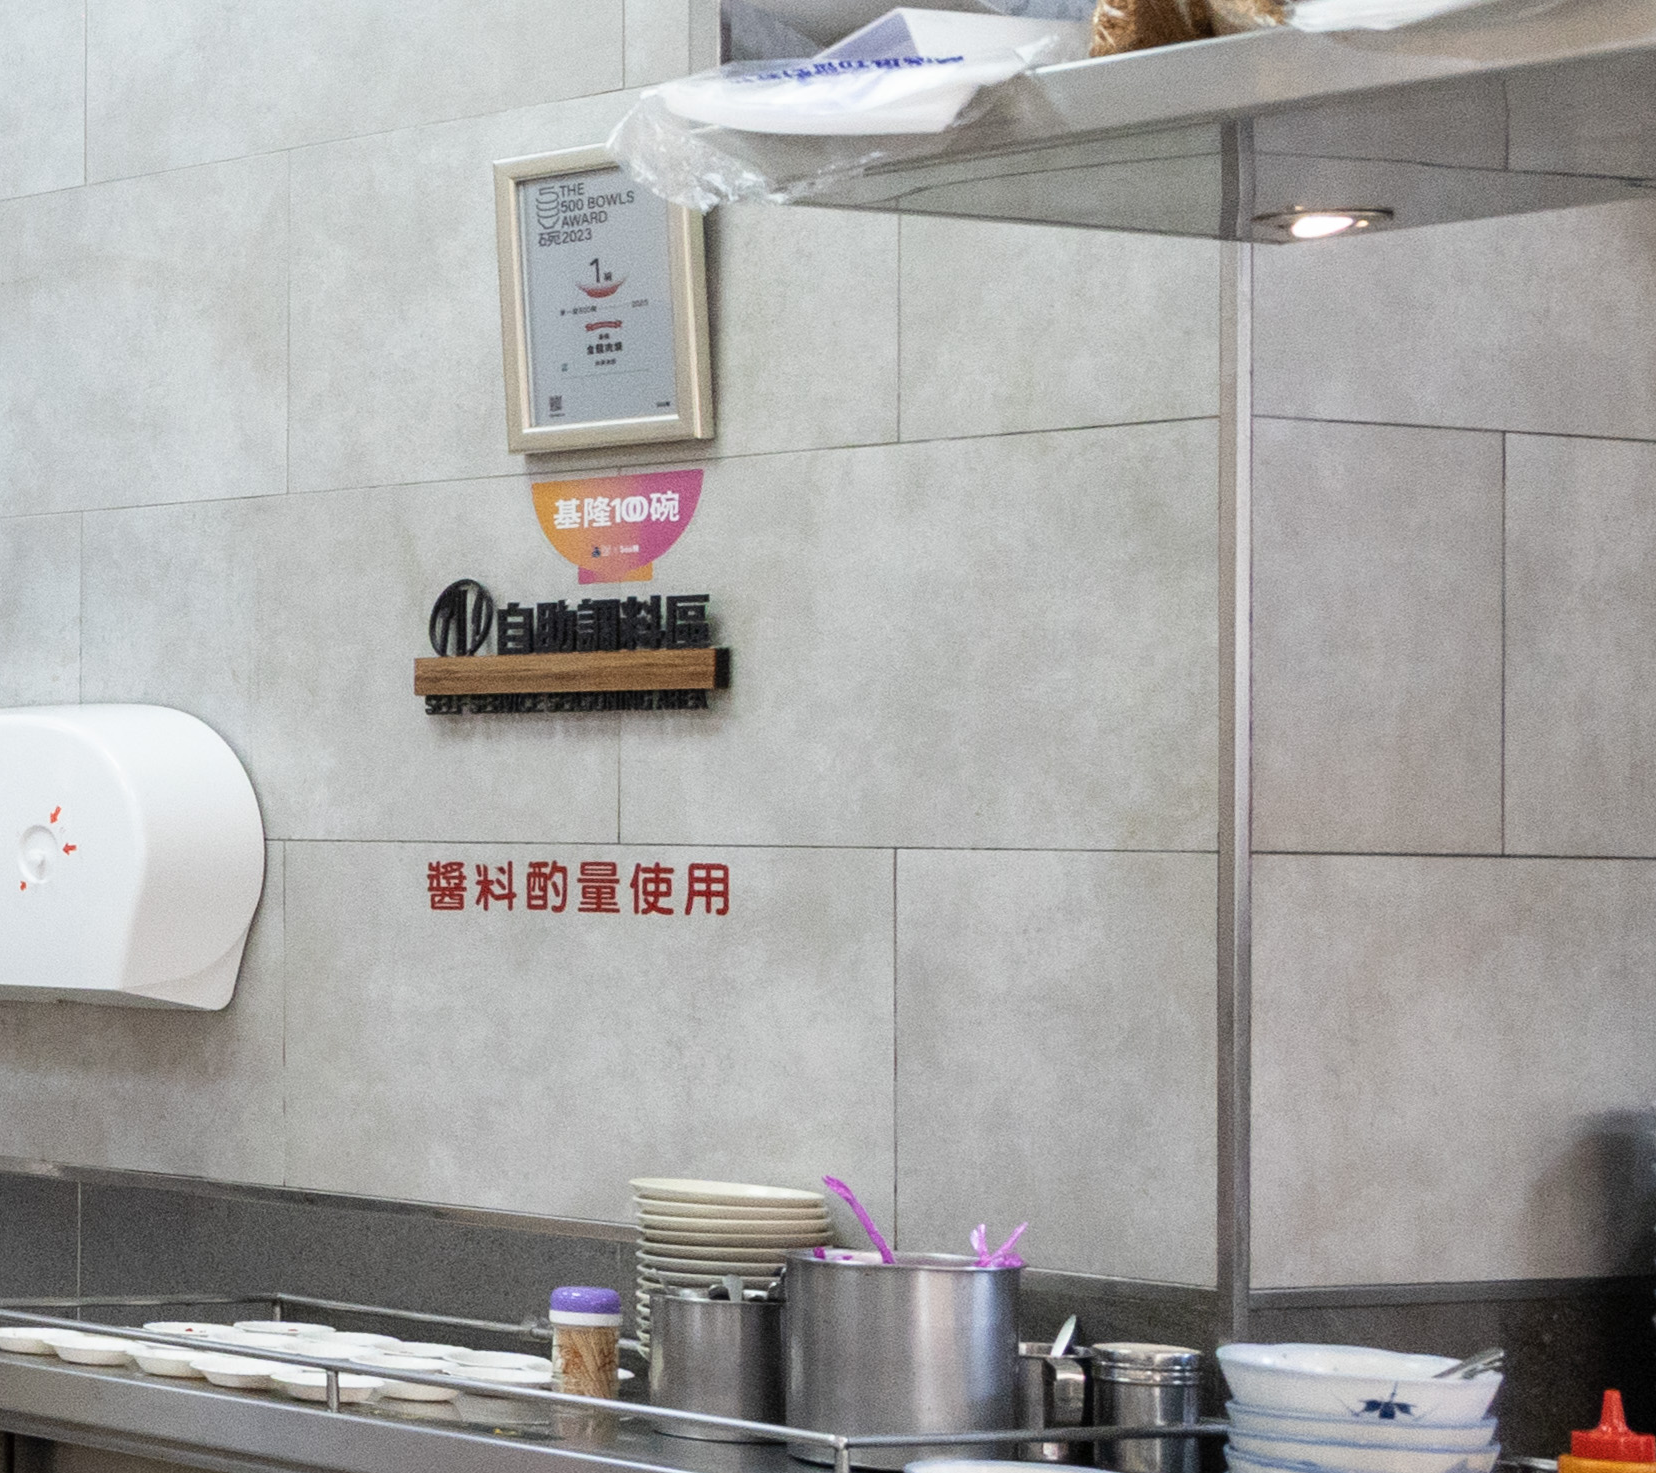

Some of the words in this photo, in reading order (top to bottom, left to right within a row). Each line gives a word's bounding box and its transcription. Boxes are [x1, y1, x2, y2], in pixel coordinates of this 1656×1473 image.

[559, 183, 585, 198] THE
[560, 198, 584, 214] 500
[587, 190, 635, 209] BOWLS
[561, 210, 609, 228] AWARD
[562, 228, 593, 245] 2023
[553, 491, 680, 530] 基隆100碗
[497, 594, 710, 655] 自助調料區
[427, 860, 730, 915] 醬料酌量使用
